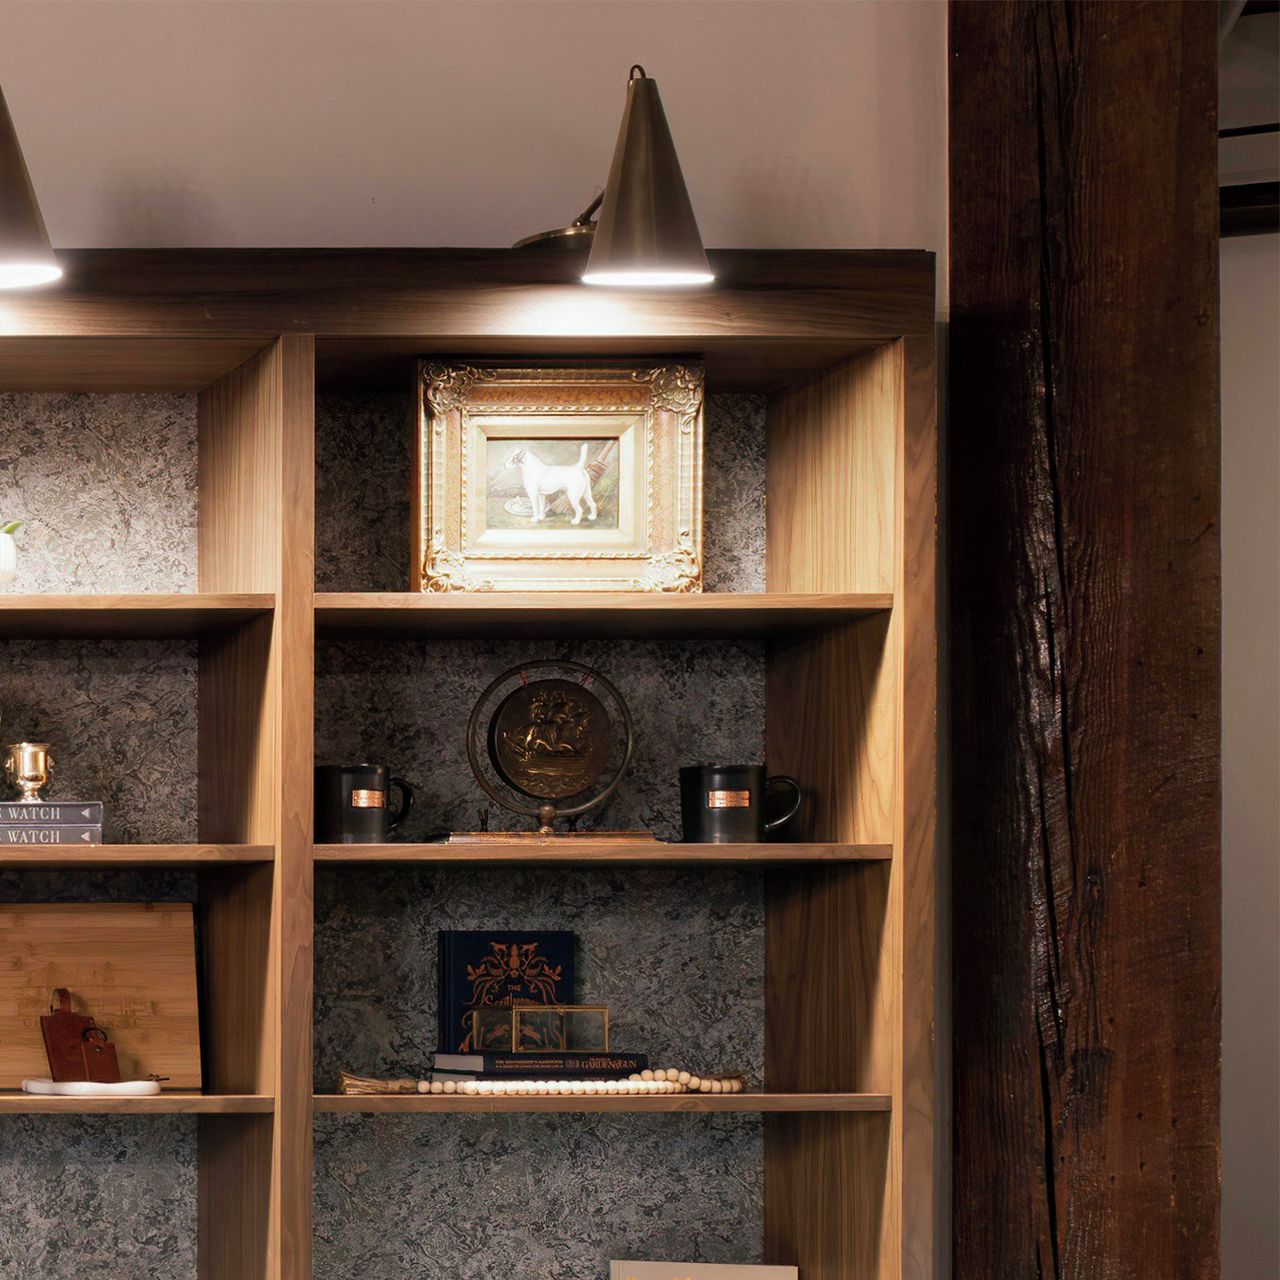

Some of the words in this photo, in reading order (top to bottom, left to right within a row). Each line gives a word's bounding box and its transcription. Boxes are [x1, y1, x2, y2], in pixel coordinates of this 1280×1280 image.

[8, 808, 61, 820] WATCH
[8, 831, 61, 843] WATCH
[507, 984, 521, 992] THE
